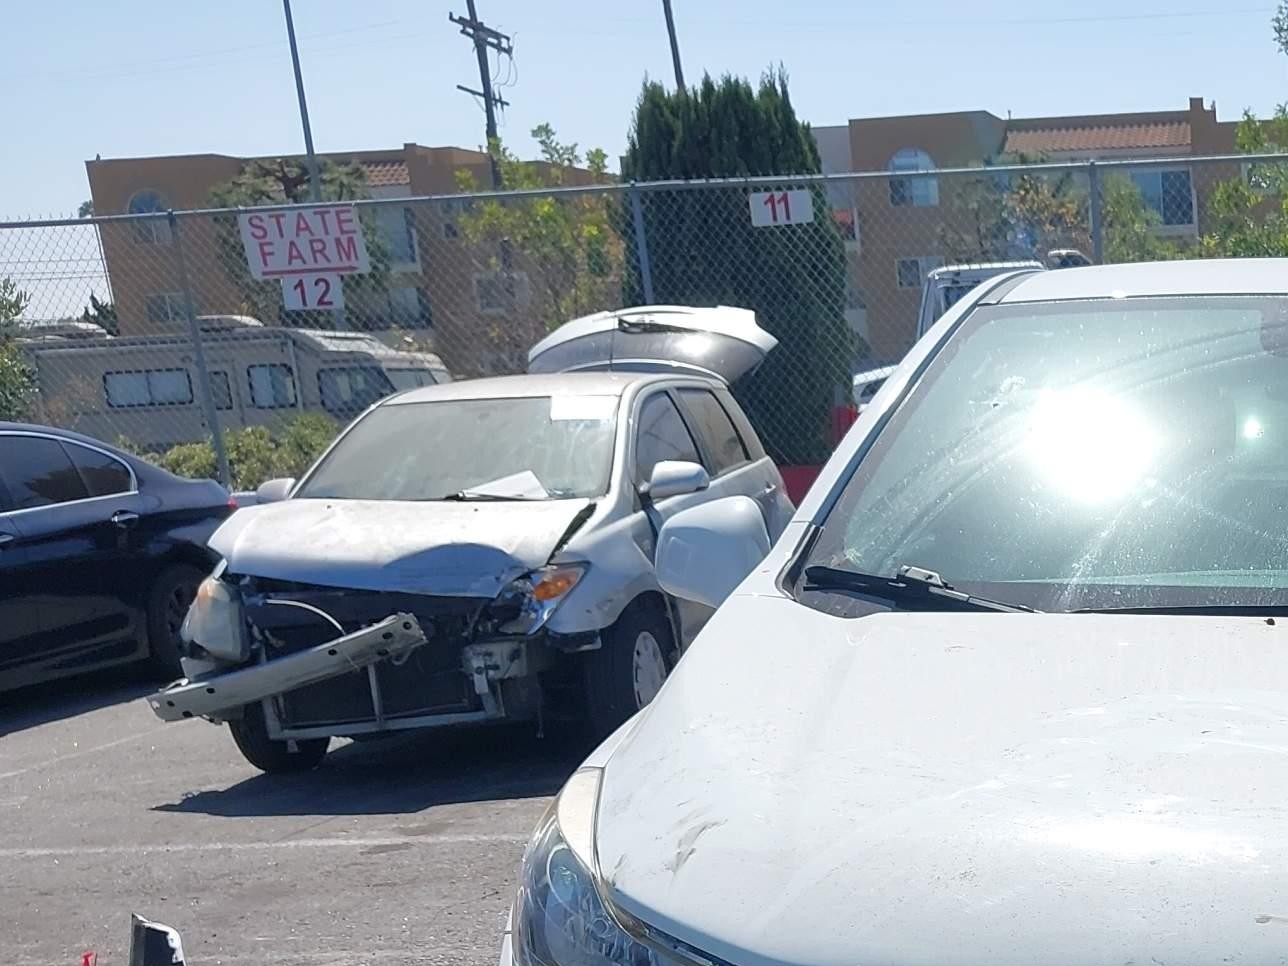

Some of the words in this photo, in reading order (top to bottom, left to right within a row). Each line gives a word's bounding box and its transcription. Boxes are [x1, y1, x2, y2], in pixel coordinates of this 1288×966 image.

[763, 191, 791, 223] 11
[247, 207, 358, 240] STATE
[258, 235, 359, 267] FARM
[293, 277, 334, 307] 12
